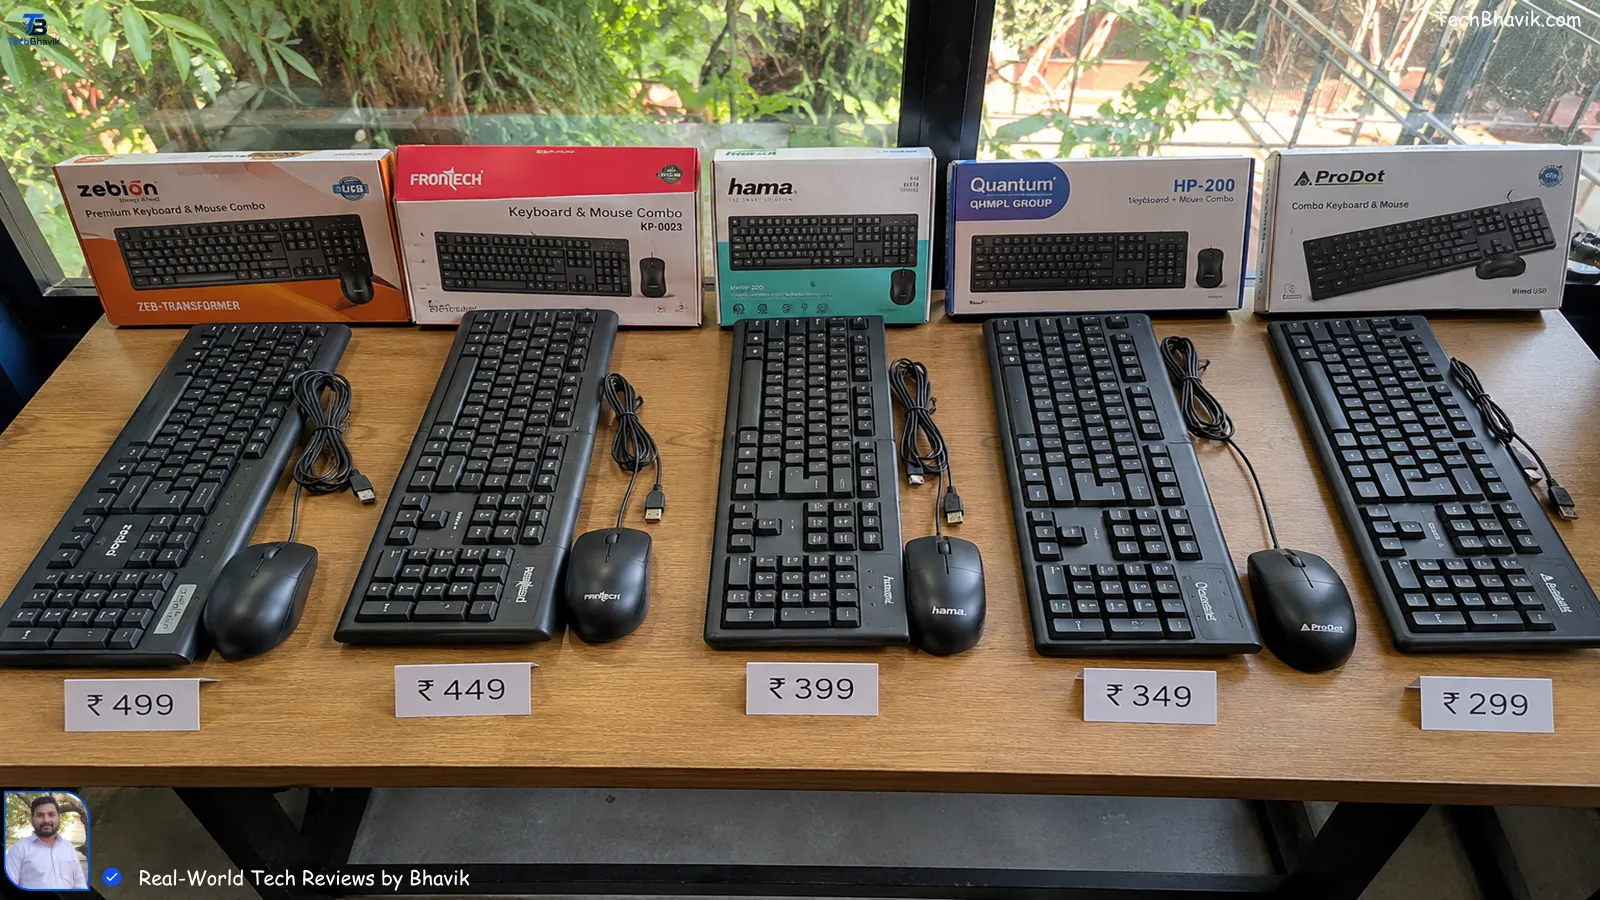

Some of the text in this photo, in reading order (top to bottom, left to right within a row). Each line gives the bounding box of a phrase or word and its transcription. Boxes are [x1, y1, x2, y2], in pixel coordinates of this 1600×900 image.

[410, 166, 483, 190] FRONTECH
[1315, 170, 1386, 183] ProDot
[970, 177, 1054, 193] Quantum
[1173, 178, 1236, 192] HP-200
[970, 199, 1053, 210] QHMPL GROUP
[1205, 195, 1234, 203] Combo
[1291, 202, 1324, 210] Combo
[1326, 201, 1369, 211] Keyboard
[85, 201, 266, 219] Premium Keyboard & Mouse Combo
[508, 206, 683, 219] Keyboard & Mouse Combo
[640, 222, 682, 231] KP-0023
[137, 300, 240, 312] ZEB-TRANSFORMER
[1311, 623, 1344, 633] ProDot
[417, 678, 506, 701] ₹ 449
[768, 677, 855, 700] ₹ 399
[1106, 684, 1192, 708] ₹ 349
[87, 694, 174, 716] ₹ 499
[1443, 692, 1528, 716] ₹ 299
